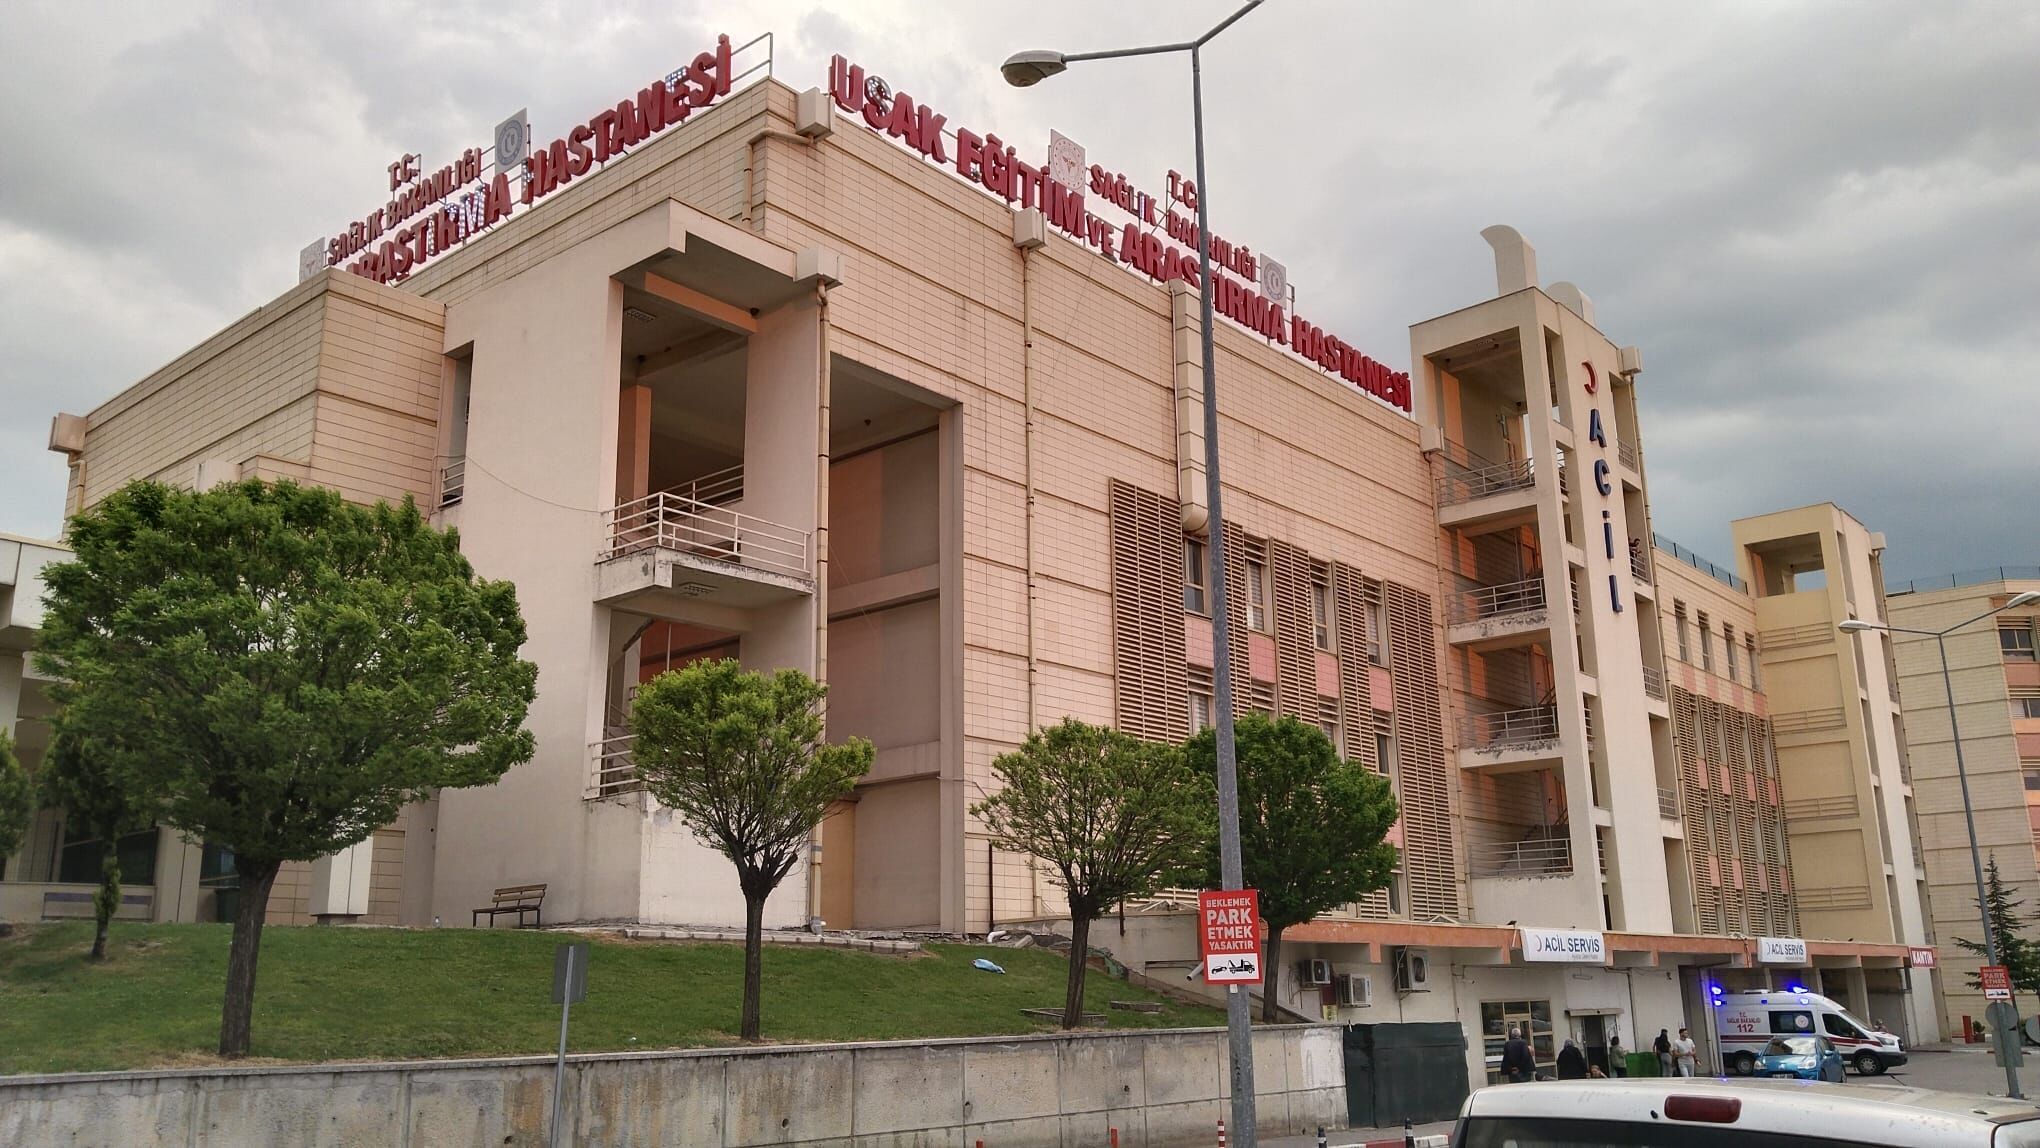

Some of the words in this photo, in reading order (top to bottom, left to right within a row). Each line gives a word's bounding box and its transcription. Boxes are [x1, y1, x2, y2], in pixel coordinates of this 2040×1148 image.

[346, 172, 513, 282] RAŞTIRMA
[521, 34, 732, 204] HASTANESİ
[387, 153, 419, 192] T.C.
[327, 208, 385, 266] SAĞLIK
[386, 147, 482, 230] BAKANLIĞI
[1091, 164, 1158, 226] SAĞLIK
[957, 127, 1085, 239] EĞİTİM
[1087, 214, 1115, 256] VE
[1291, 314, 1412, 413] HASTANESİ
[1589, 408, 1624, 614] ACİL
[1206, 898, 1252, 908] BEKLEMEK
[1206, 908, 1253, 926] PARK
[1207, 925, 1254, 940] ETMEK
[1209, 940, 1254, 950] YASAKTIR
[1545, 934, 1566, 952] ACİL
[1568, 936, 1600, 953] SERVİS
[1737, 1023, 1754, 1033] 112
